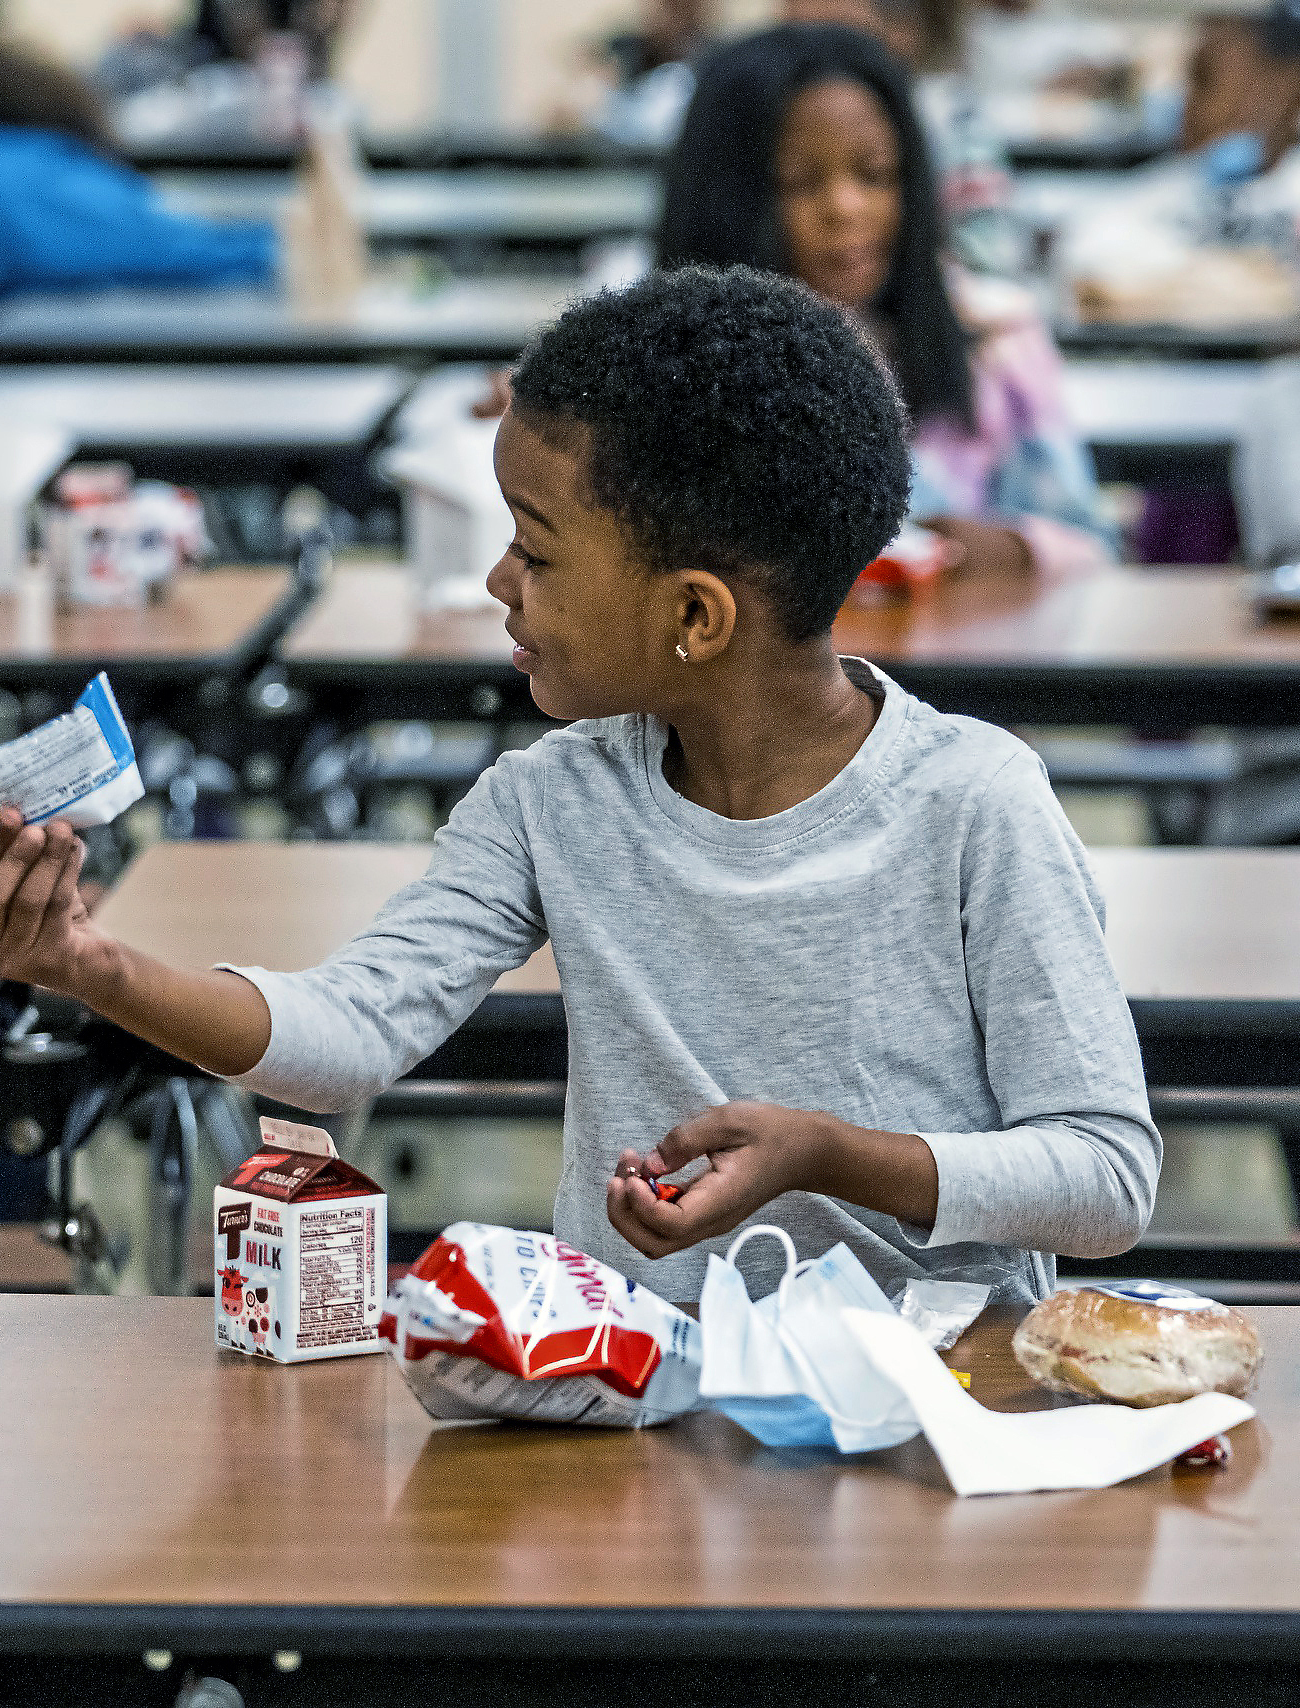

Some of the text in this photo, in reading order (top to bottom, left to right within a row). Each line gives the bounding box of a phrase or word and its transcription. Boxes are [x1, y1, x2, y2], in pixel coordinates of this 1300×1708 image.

[220, 1209, 248, 1229] Turner's
[257, 1208, 267, 1219] FAT
[301, 1213, 337, 1221] Nutrition
[254, 1221, 283, 1238] CHOCOLATE
[302, 1235, 363, 1250] Calories 120
[246, 1240, 281, 1271] MILK
